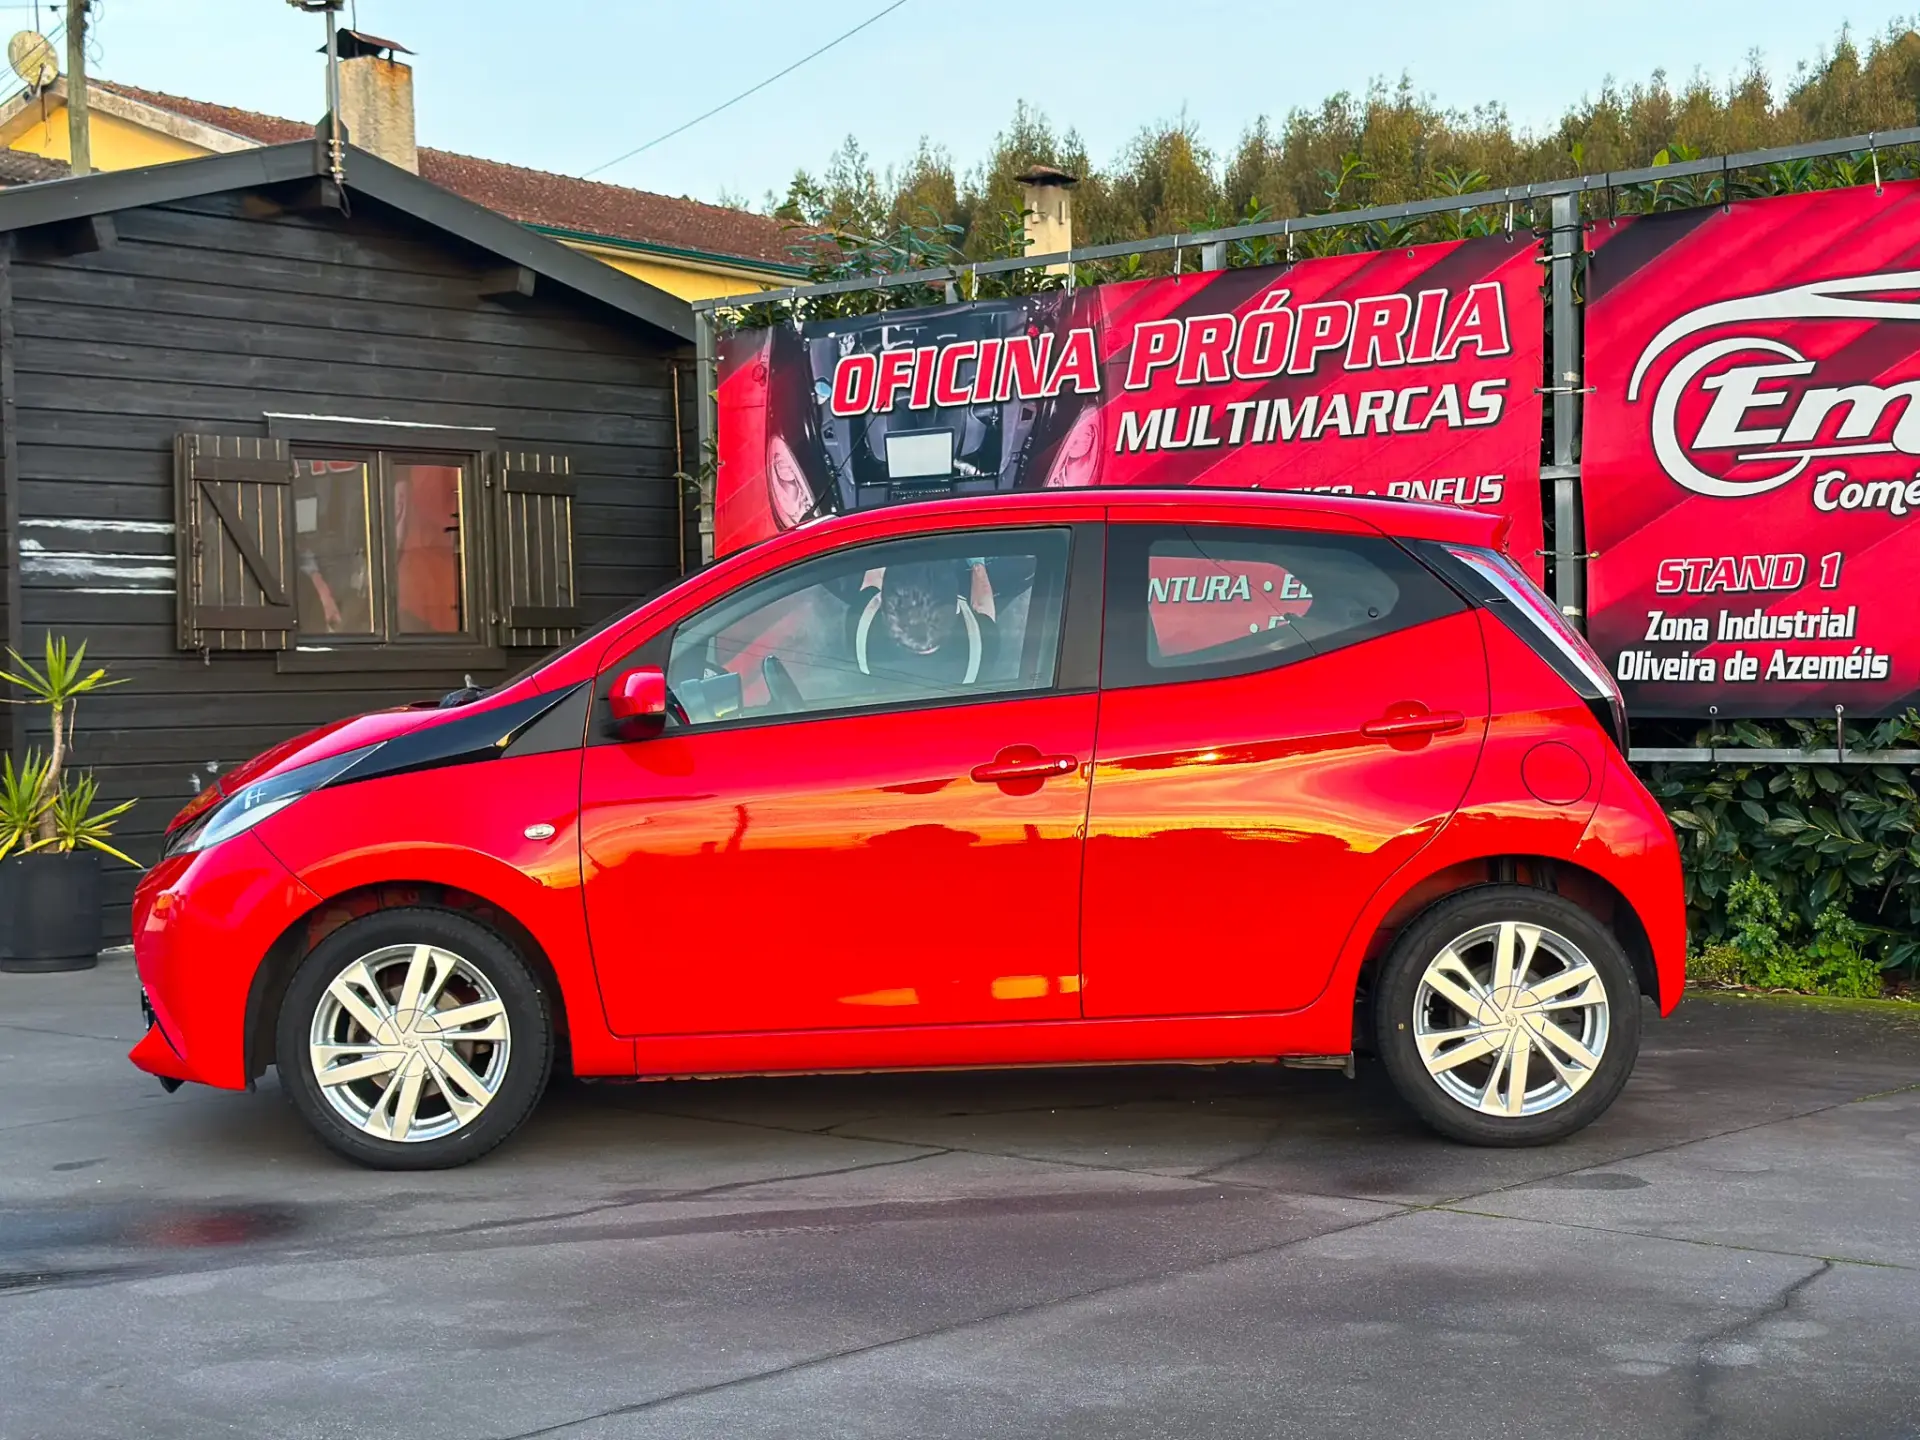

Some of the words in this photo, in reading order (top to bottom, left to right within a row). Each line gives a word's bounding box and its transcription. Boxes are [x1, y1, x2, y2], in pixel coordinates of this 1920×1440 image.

[830, 328, 1101, 416] OFICINA
[1124, 282, 1511, 391] PRÓPRIA
[1115, 379, 1507, 452] MULTIMARCAS
[1655, 553, 1806, 594] STAND
[1819, 552, 1842, 589] 1
[1644, 611, 1709, 642] Zona
[1717, 606, 1857, 641] Industrial
[1617, 650, 1716, 682] Oliveira
[1723, 651, 1757, 681] de
[1764, 646, 1889, 680] Azeméis
